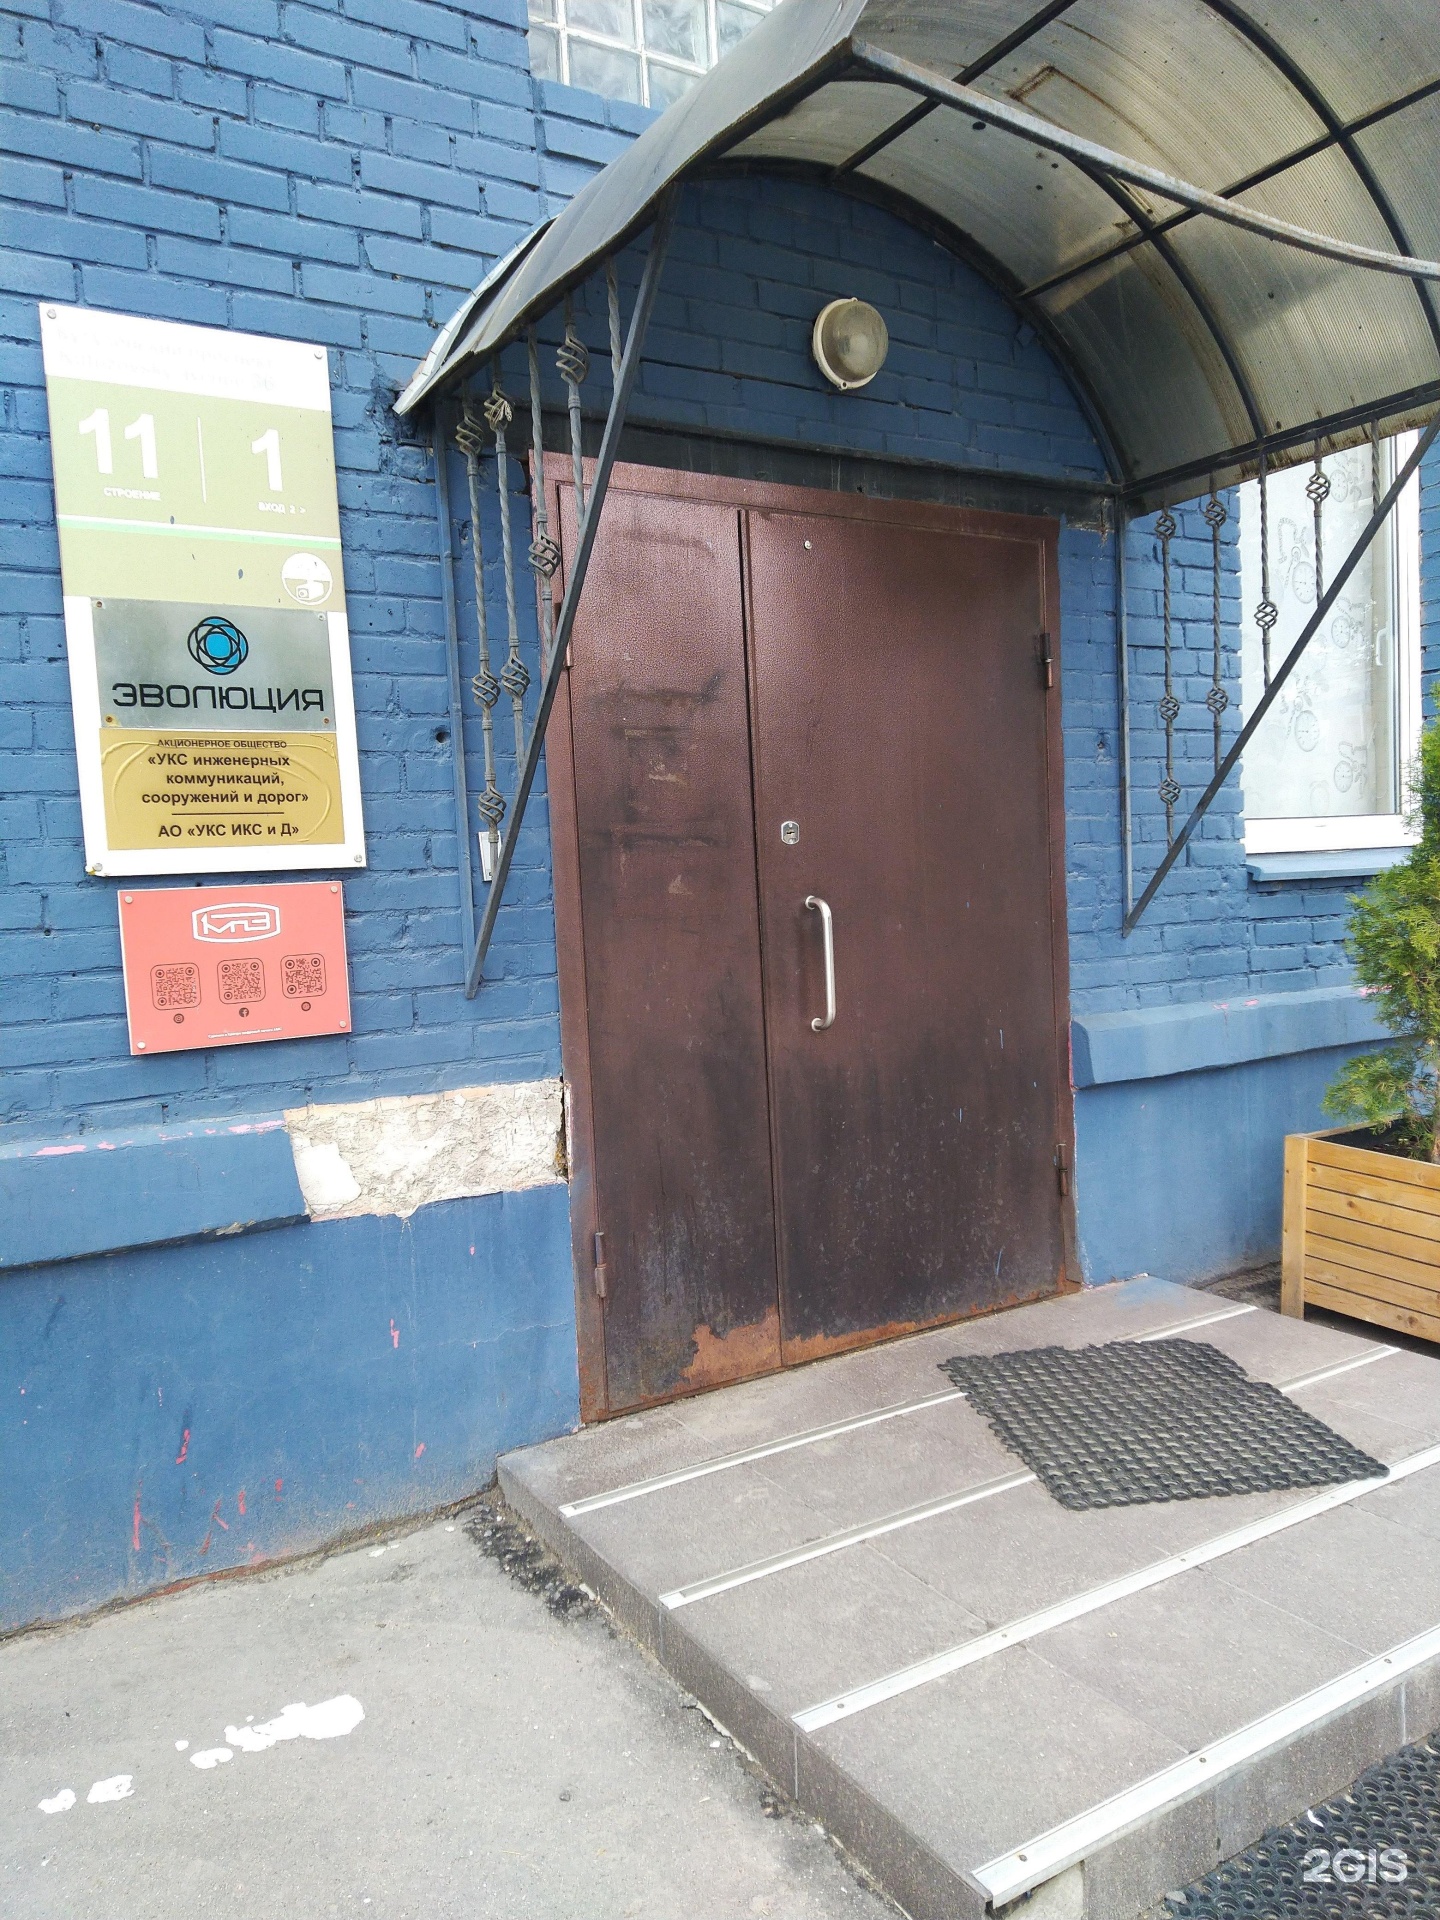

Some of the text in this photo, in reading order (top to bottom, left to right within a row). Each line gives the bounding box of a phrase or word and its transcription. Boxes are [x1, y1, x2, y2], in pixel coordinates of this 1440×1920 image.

[79, 408, 159, 479] 11
[251, 428, 284, 492] 1
[104, 487, 162, 501] СТРОЕНИЕ
[258, 501, 286, 515] ВХОД
[112, 683, 324, 713] ЭВОЛЮЦИЯ
[157, 739, 287, 749] АКЦИОНЕРНОЕ ОБЩЕСТВО
[148, 753, 290, 768] «УКС инженерных
[166, 772, 285, 787] коммуникаций,
[142, 791, 309, 806] сооружений и дорог»
[158, 823, 299, 838] АО «УКС ИКС и Д»
